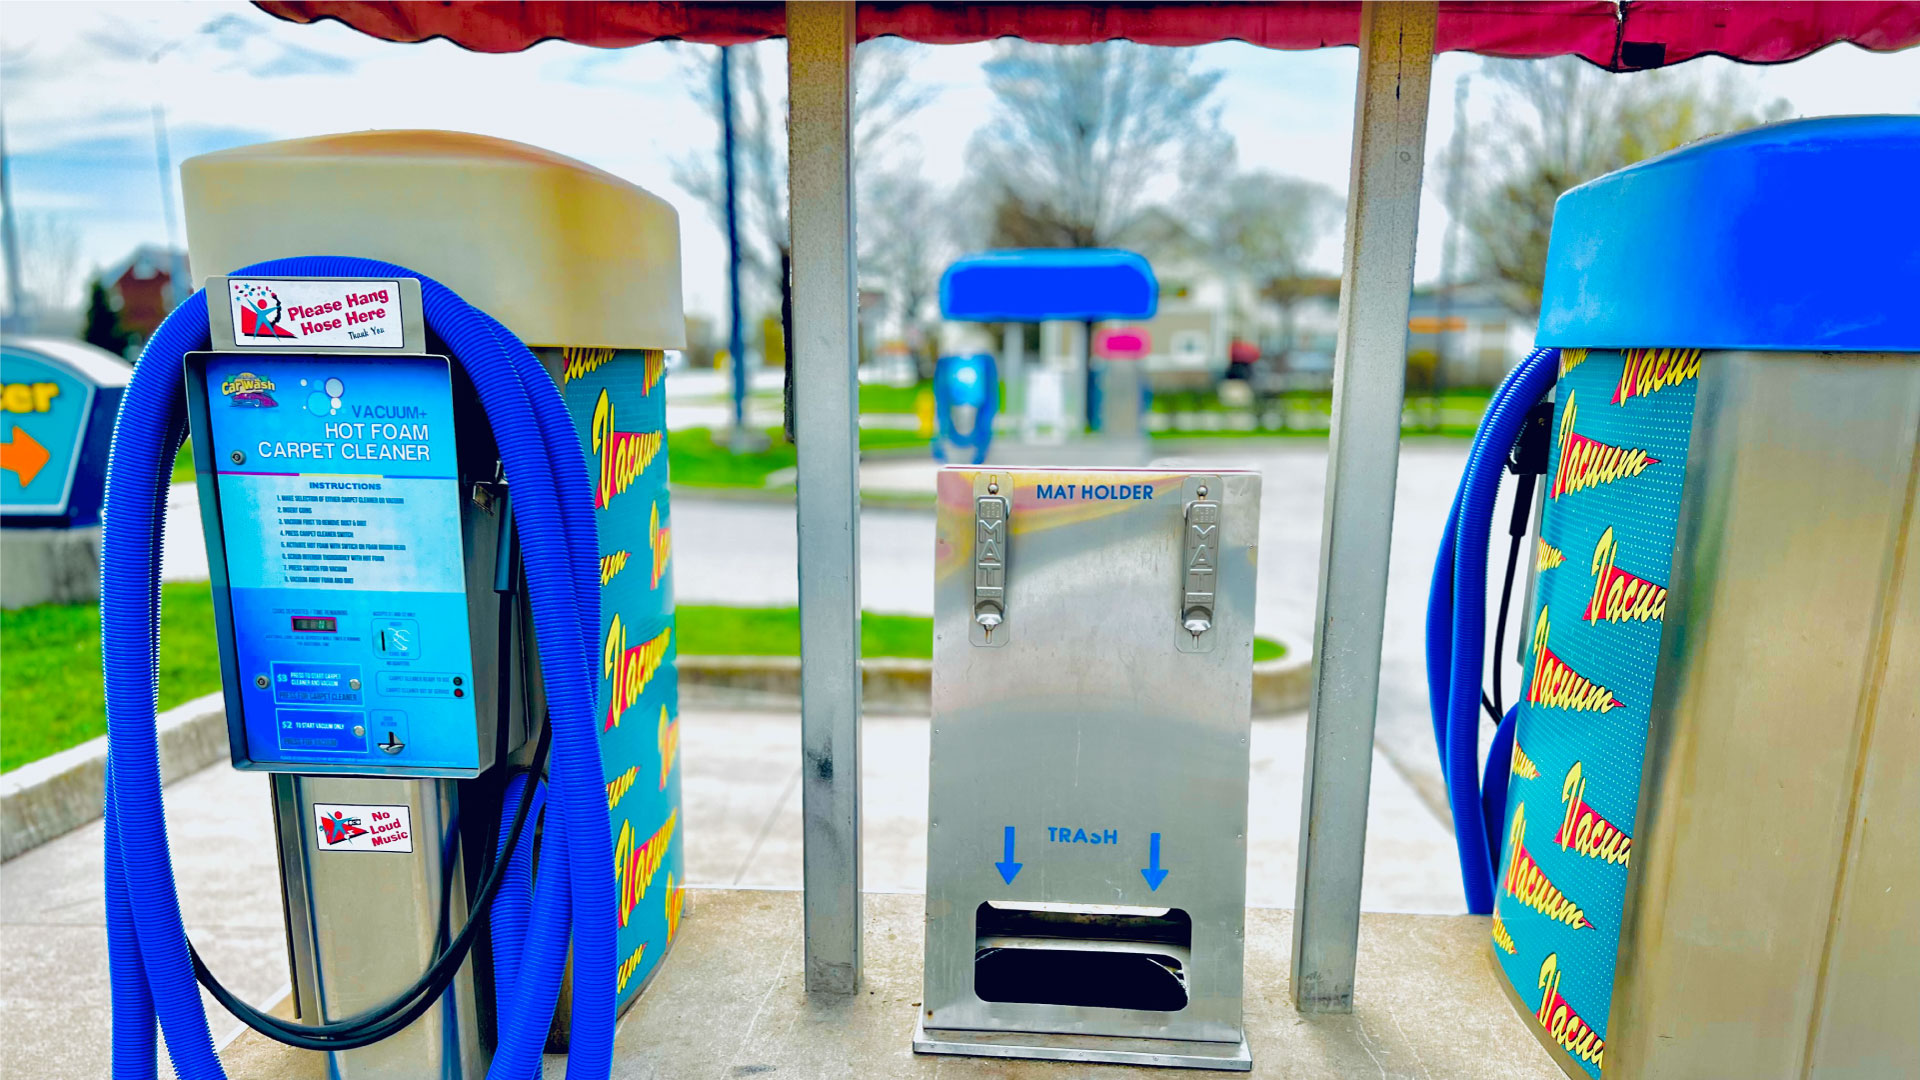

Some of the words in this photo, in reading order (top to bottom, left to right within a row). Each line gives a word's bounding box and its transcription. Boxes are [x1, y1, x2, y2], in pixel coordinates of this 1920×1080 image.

[287, 301, 343, 322] Please
[345, 289, 389, 308] Hang
[300, 318, 342, 336] Hose
[345, 307, 386, 326] Here
[348, 328, 370, 341] Thank
[370, 326, 385, 336] You
[221, 381, 242, 396] Car
[243, 379, 276, 392] Wash
[0, 382, 60, 413] er
[351, 405, 428, 419] VACUUM+
[325, 422, 365, 439] HOT
[371, 423, 429, 441] FOAM
[258, 441, 335, 459] CARPET
[341, 443, 430, 461] CLEANER
[592, 387, 662, 510] Vacuum
[1555, 388, 1648, 503] Vacuum
[309, 482, 382, 490] INSTRUCTIONS
[1037, 484, 1076, 500] MAT
[1081, 484, 1154, 500] HOLDER
[1531, 604, 1615, 714] Vacuum
[605, 613, 672, 728] Vacuum
[282, 721, 293, 729] $2
[371, 811, 391, 822] No
[369, 818, 402, 835] Loud
[371, 831, 409, 847] Music
[1507, 800, 1586, 930] Vacuum
